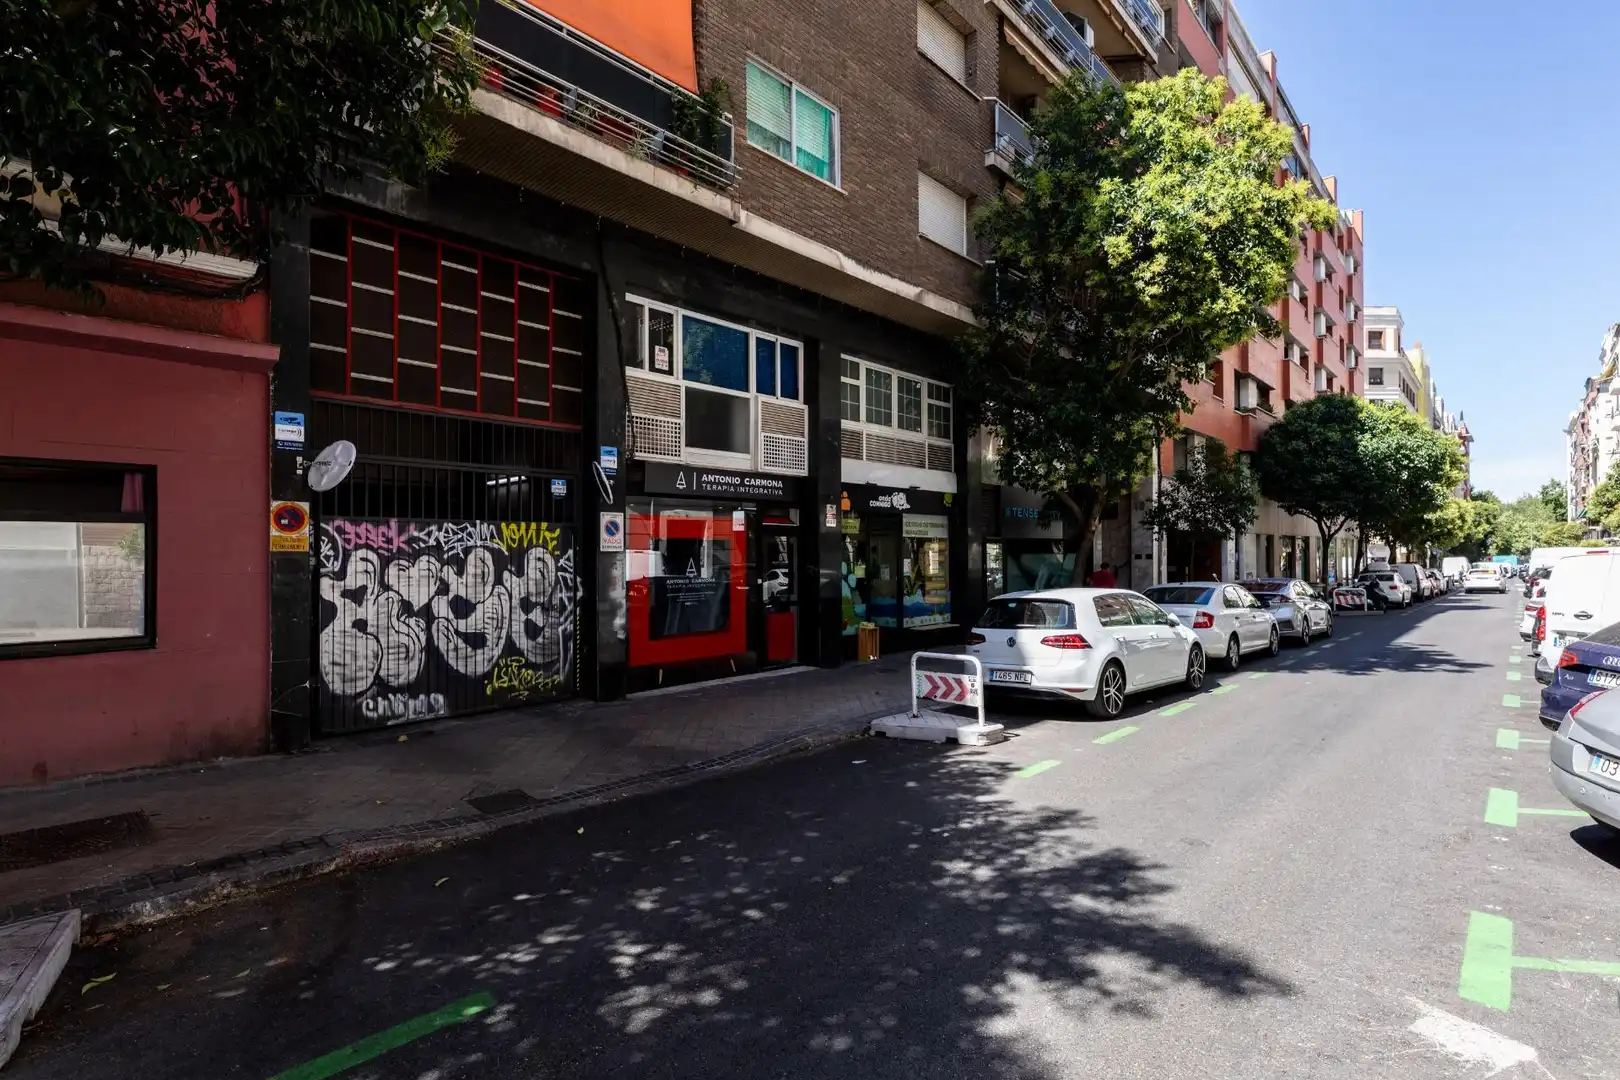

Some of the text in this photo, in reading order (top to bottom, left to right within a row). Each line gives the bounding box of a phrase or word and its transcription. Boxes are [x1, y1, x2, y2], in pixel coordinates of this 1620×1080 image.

[701, 474, 783, 488] ANTONIO CARMONA
[702, 483, 783, 495] TERAPIA INTEGRATIVA
[994, 671, 1029, 681] 1465 NFL
